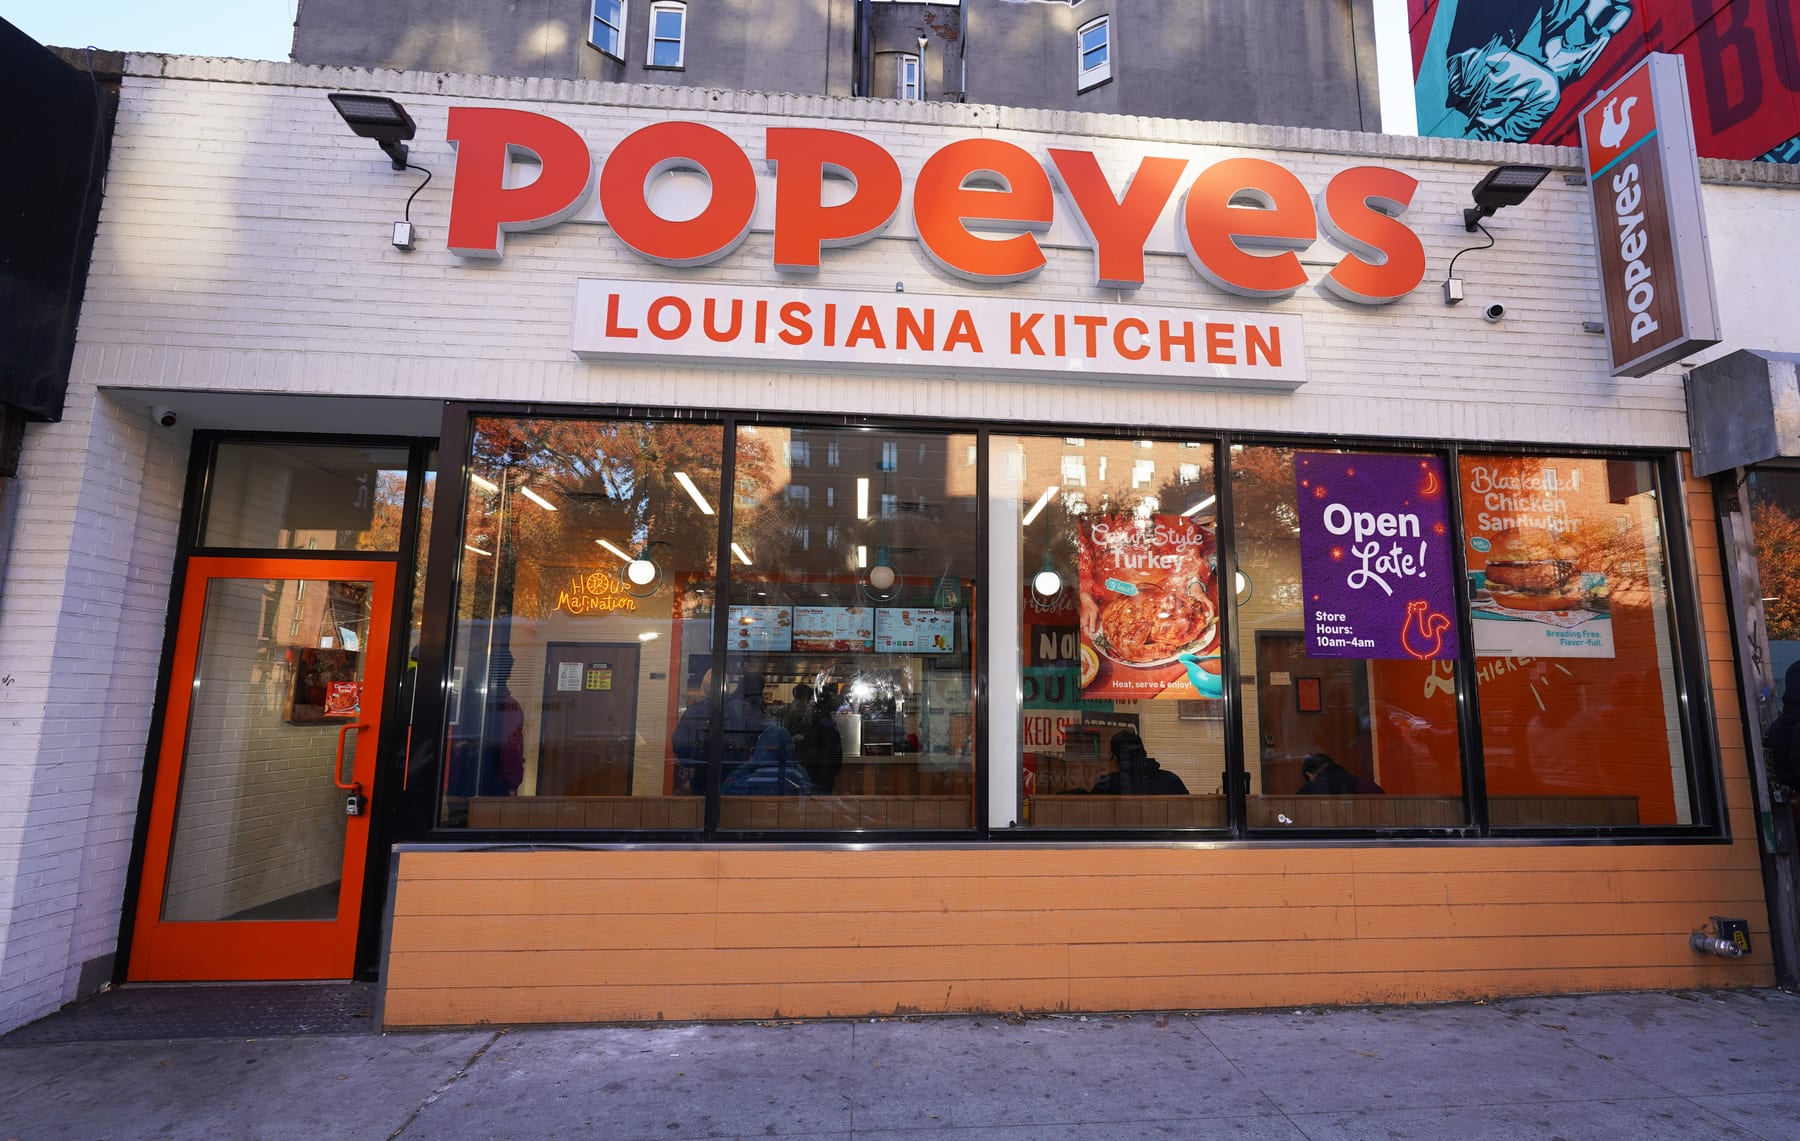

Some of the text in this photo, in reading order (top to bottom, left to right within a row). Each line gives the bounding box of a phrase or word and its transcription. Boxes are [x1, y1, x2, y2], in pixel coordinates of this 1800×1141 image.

[606, 294, 1284, 369] LOUISIANA KITCHEN
[1471, 466, 1580, 494] Blackened
[1485, 492, 1567, 513] Chicken
[1323, 503, 1421, 543] Open
[1478, 512, 1578, 533] Sandwich
[1111, 549, 1184, 573] Turkey
[1347, 540, 1428, 597] Late!
[1315, 610, 1346, 622] Store
[1316, 623, 1353, 635] Hours:
[1546, 630, 1602, 639] Breading Free.
[1316, 636, 1376, 648] 10am-4am
[1560, 639, 1603, 647] Flavor-full.
[1112, 680, 1192, 690] Heat, serve & enjoy!
